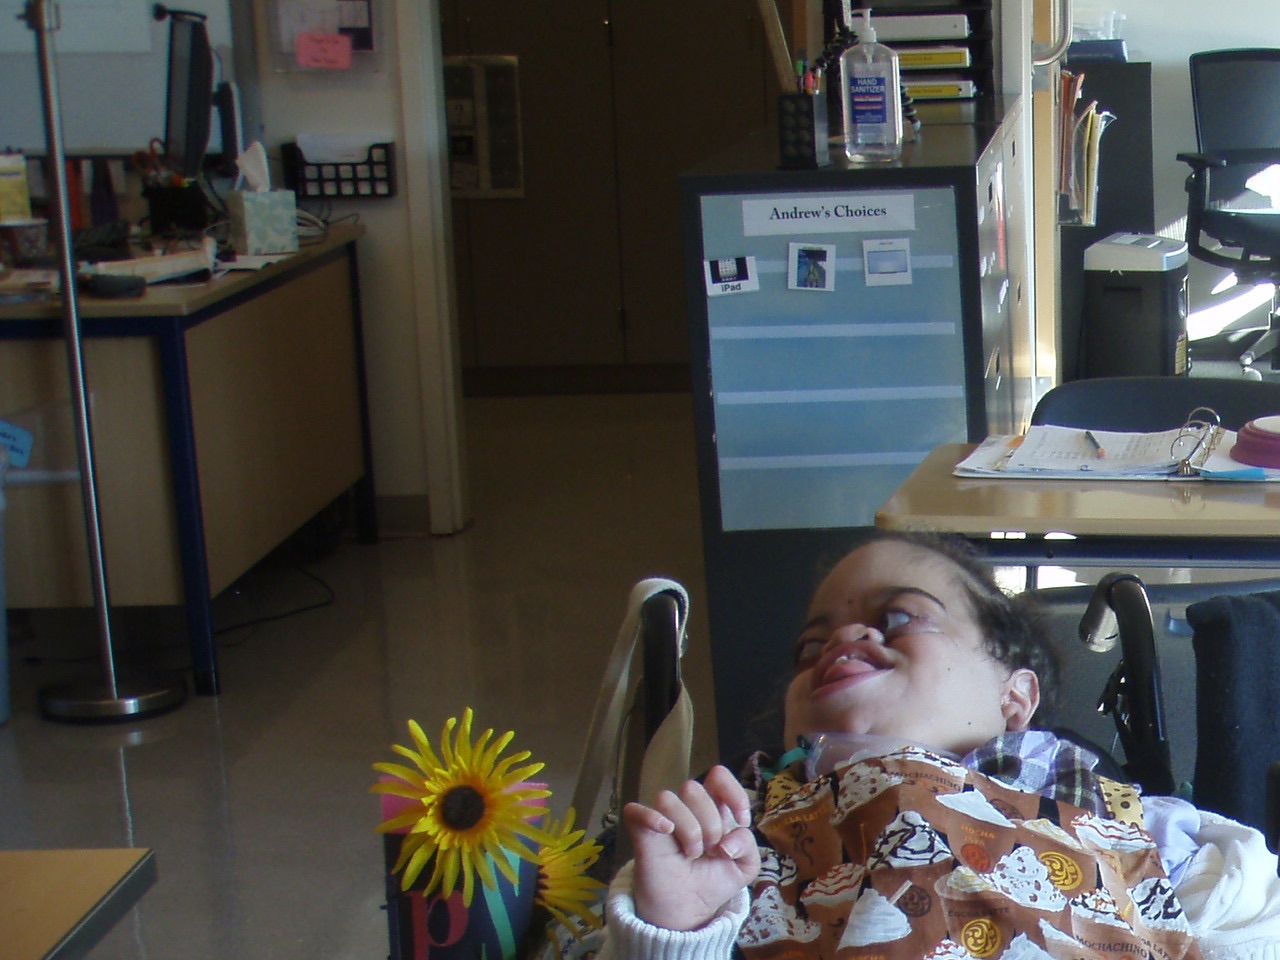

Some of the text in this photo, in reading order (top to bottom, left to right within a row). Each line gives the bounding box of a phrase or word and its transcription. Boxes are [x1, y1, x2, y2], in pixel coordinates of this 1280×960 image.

[769, 205, 887, 220] Andrew's Choices
[720, 283, 742, 292] iPad
[1075, 935, 1148, 958] MOCHACHINO
